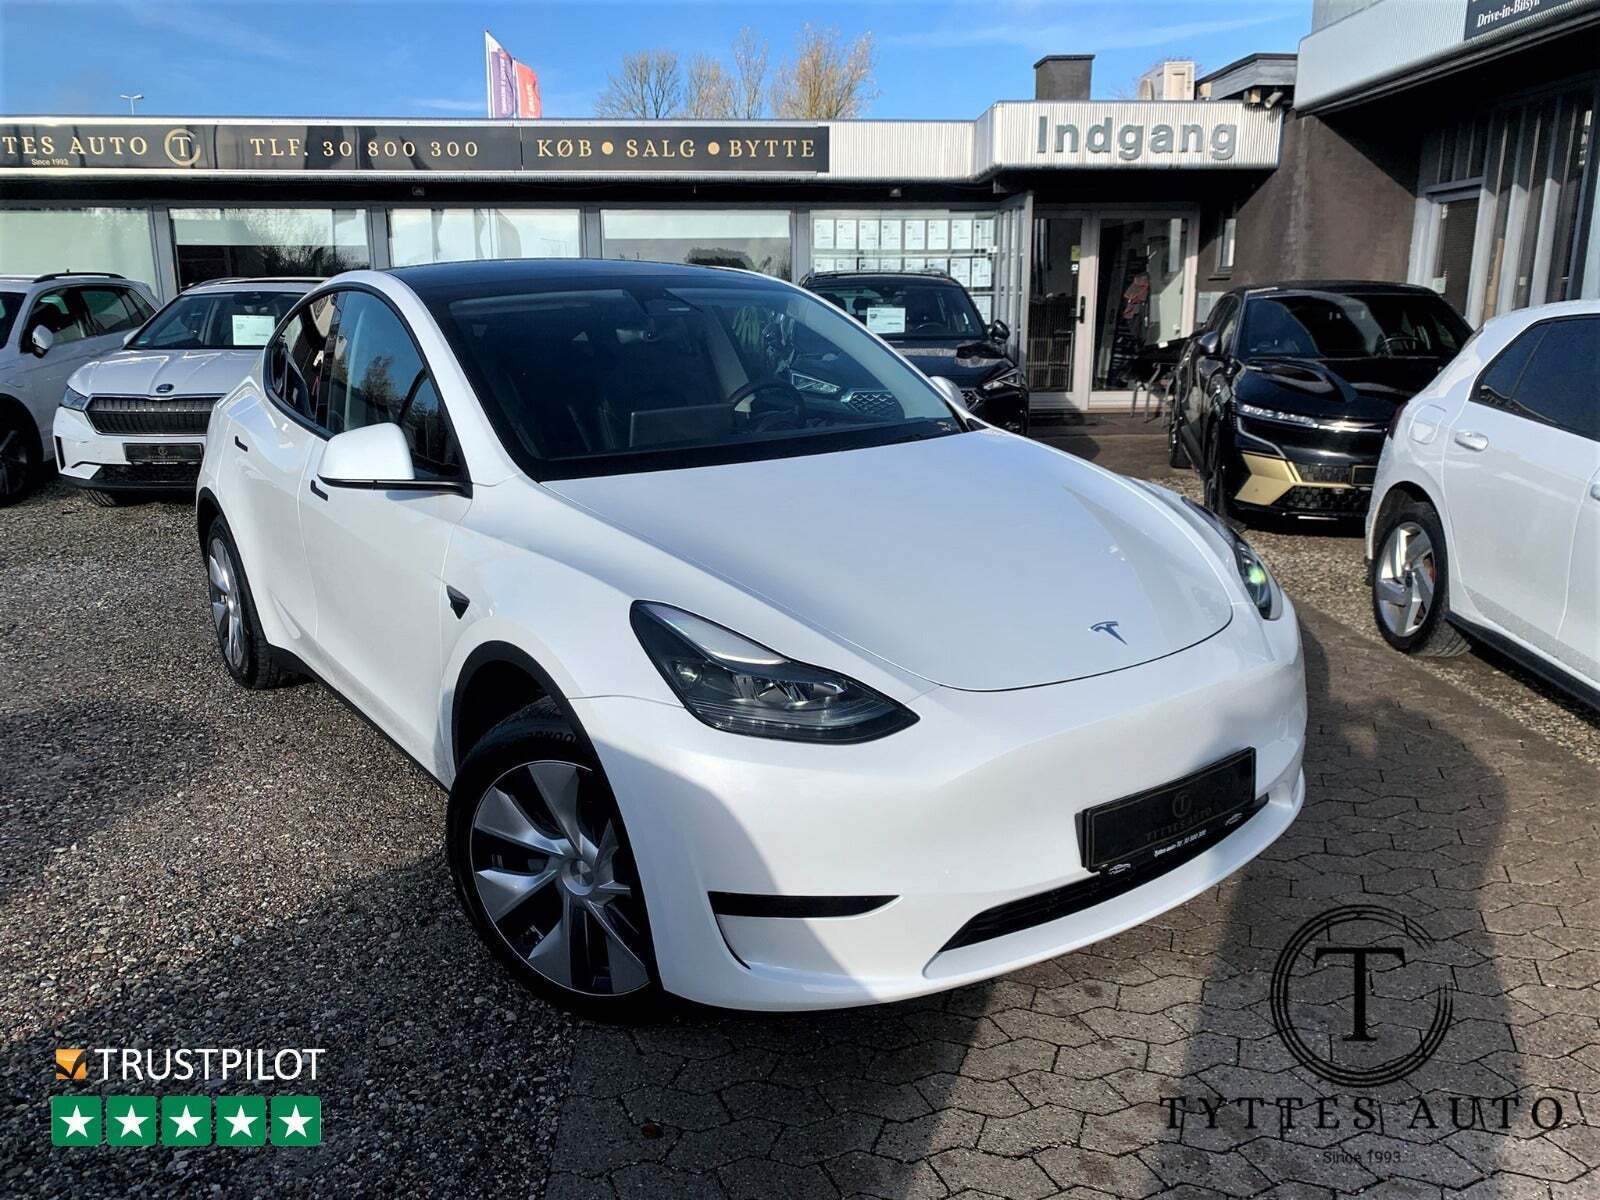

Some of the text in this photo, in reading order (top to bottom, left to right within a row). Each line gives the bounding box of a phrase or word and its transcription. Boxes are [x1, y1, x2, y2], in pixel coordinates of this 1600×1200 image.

[2, 136, 147, 155] TES AUTO
[1037, 116, 1237, 160] Indgang
[250, 138, 478, 158] TLF. 30 800 300
[537, 139, 815, 158] KØB SALG BYTTE
[31, 158, 69, 166] Since 1993
